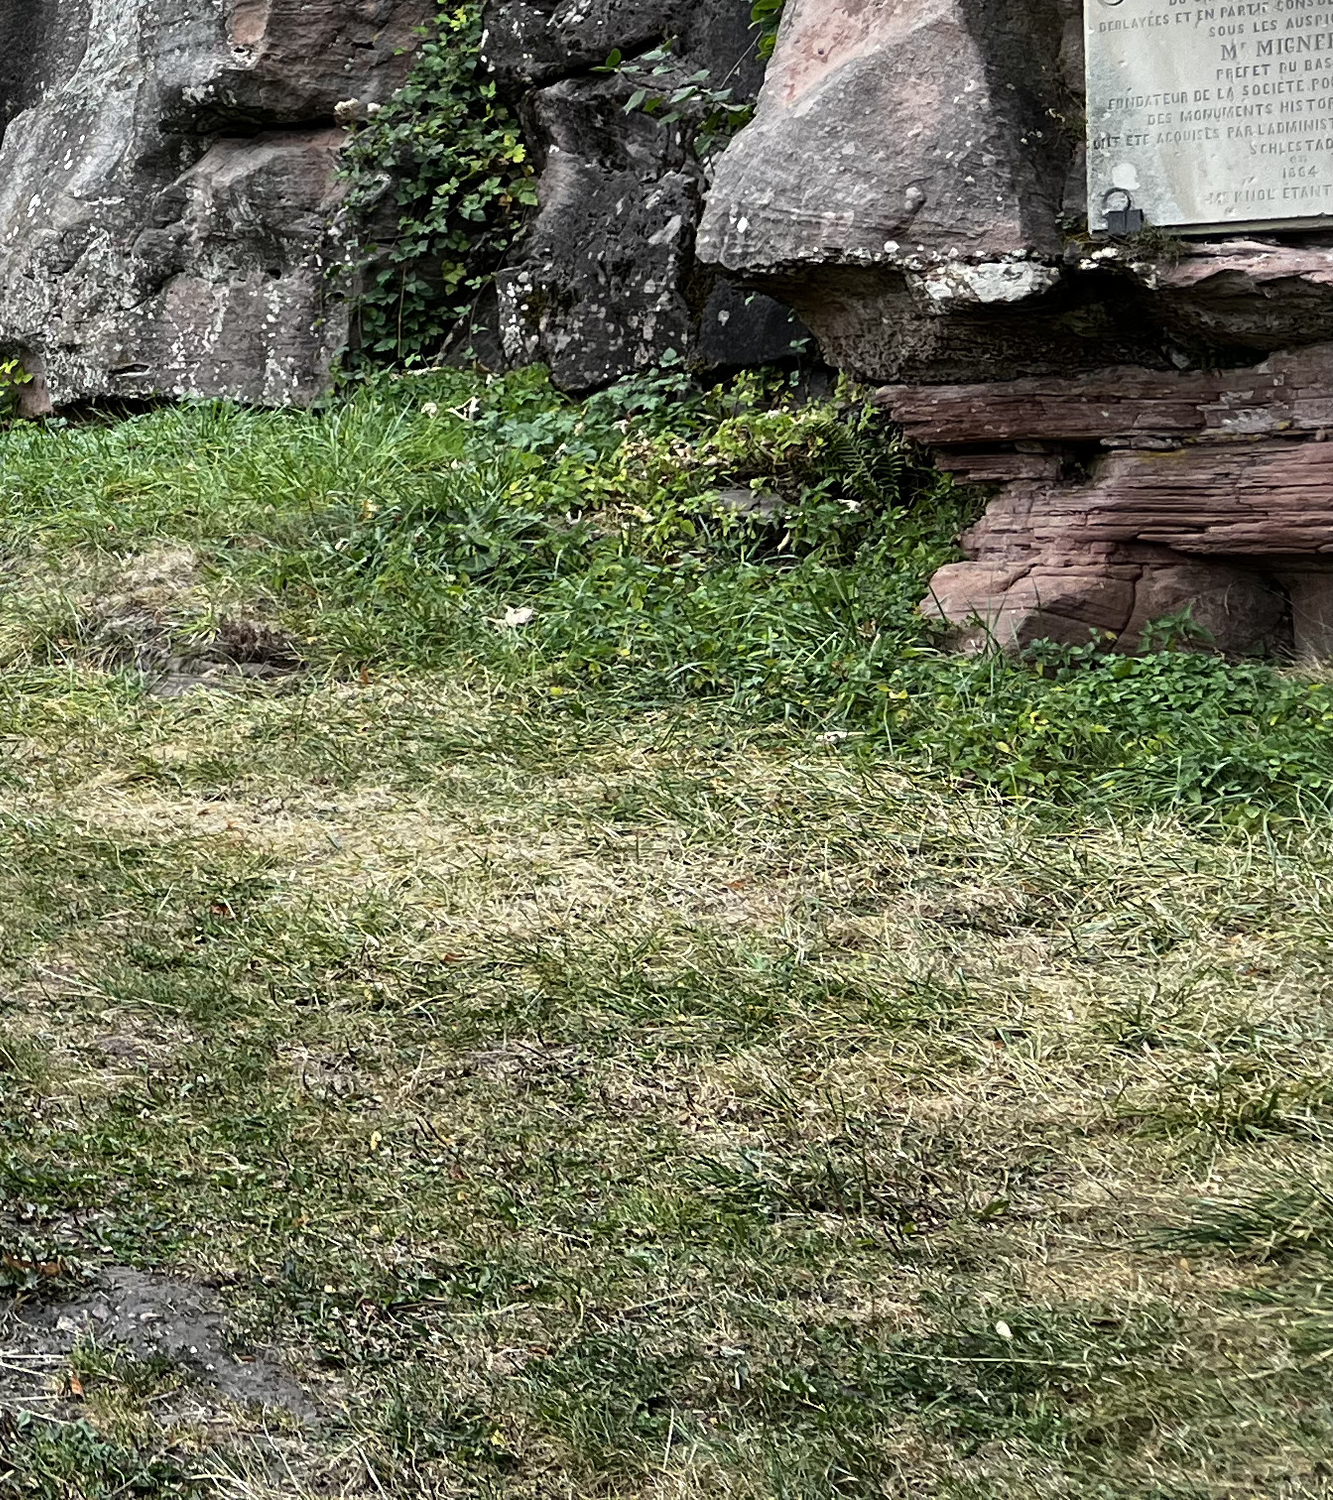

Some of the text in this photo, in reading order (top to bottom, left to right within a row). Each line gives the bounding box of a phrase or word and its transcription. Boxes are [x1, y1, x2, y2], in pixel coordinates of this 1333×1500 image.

[1175, 11, 1192, 24] ET
[1197, 8, 1215, 21] EN
[1208, 23, 1245, 37] SOUS
[1253, 19, 1278, 33] LES
[1279, 60, 1297, 74] DU
[1107, 91, 1188, 110] FONDATEUR
[1193, 89, 1211, 102] DE
[1217, 86, 1234, 101] LA
[1312, 77, 1333, 91] PO
[1147, 112, 1173, 126] DES
[1180, 103, 1273, 122] MONUMENTS
[1227, 125, 1253, 139] PAR
